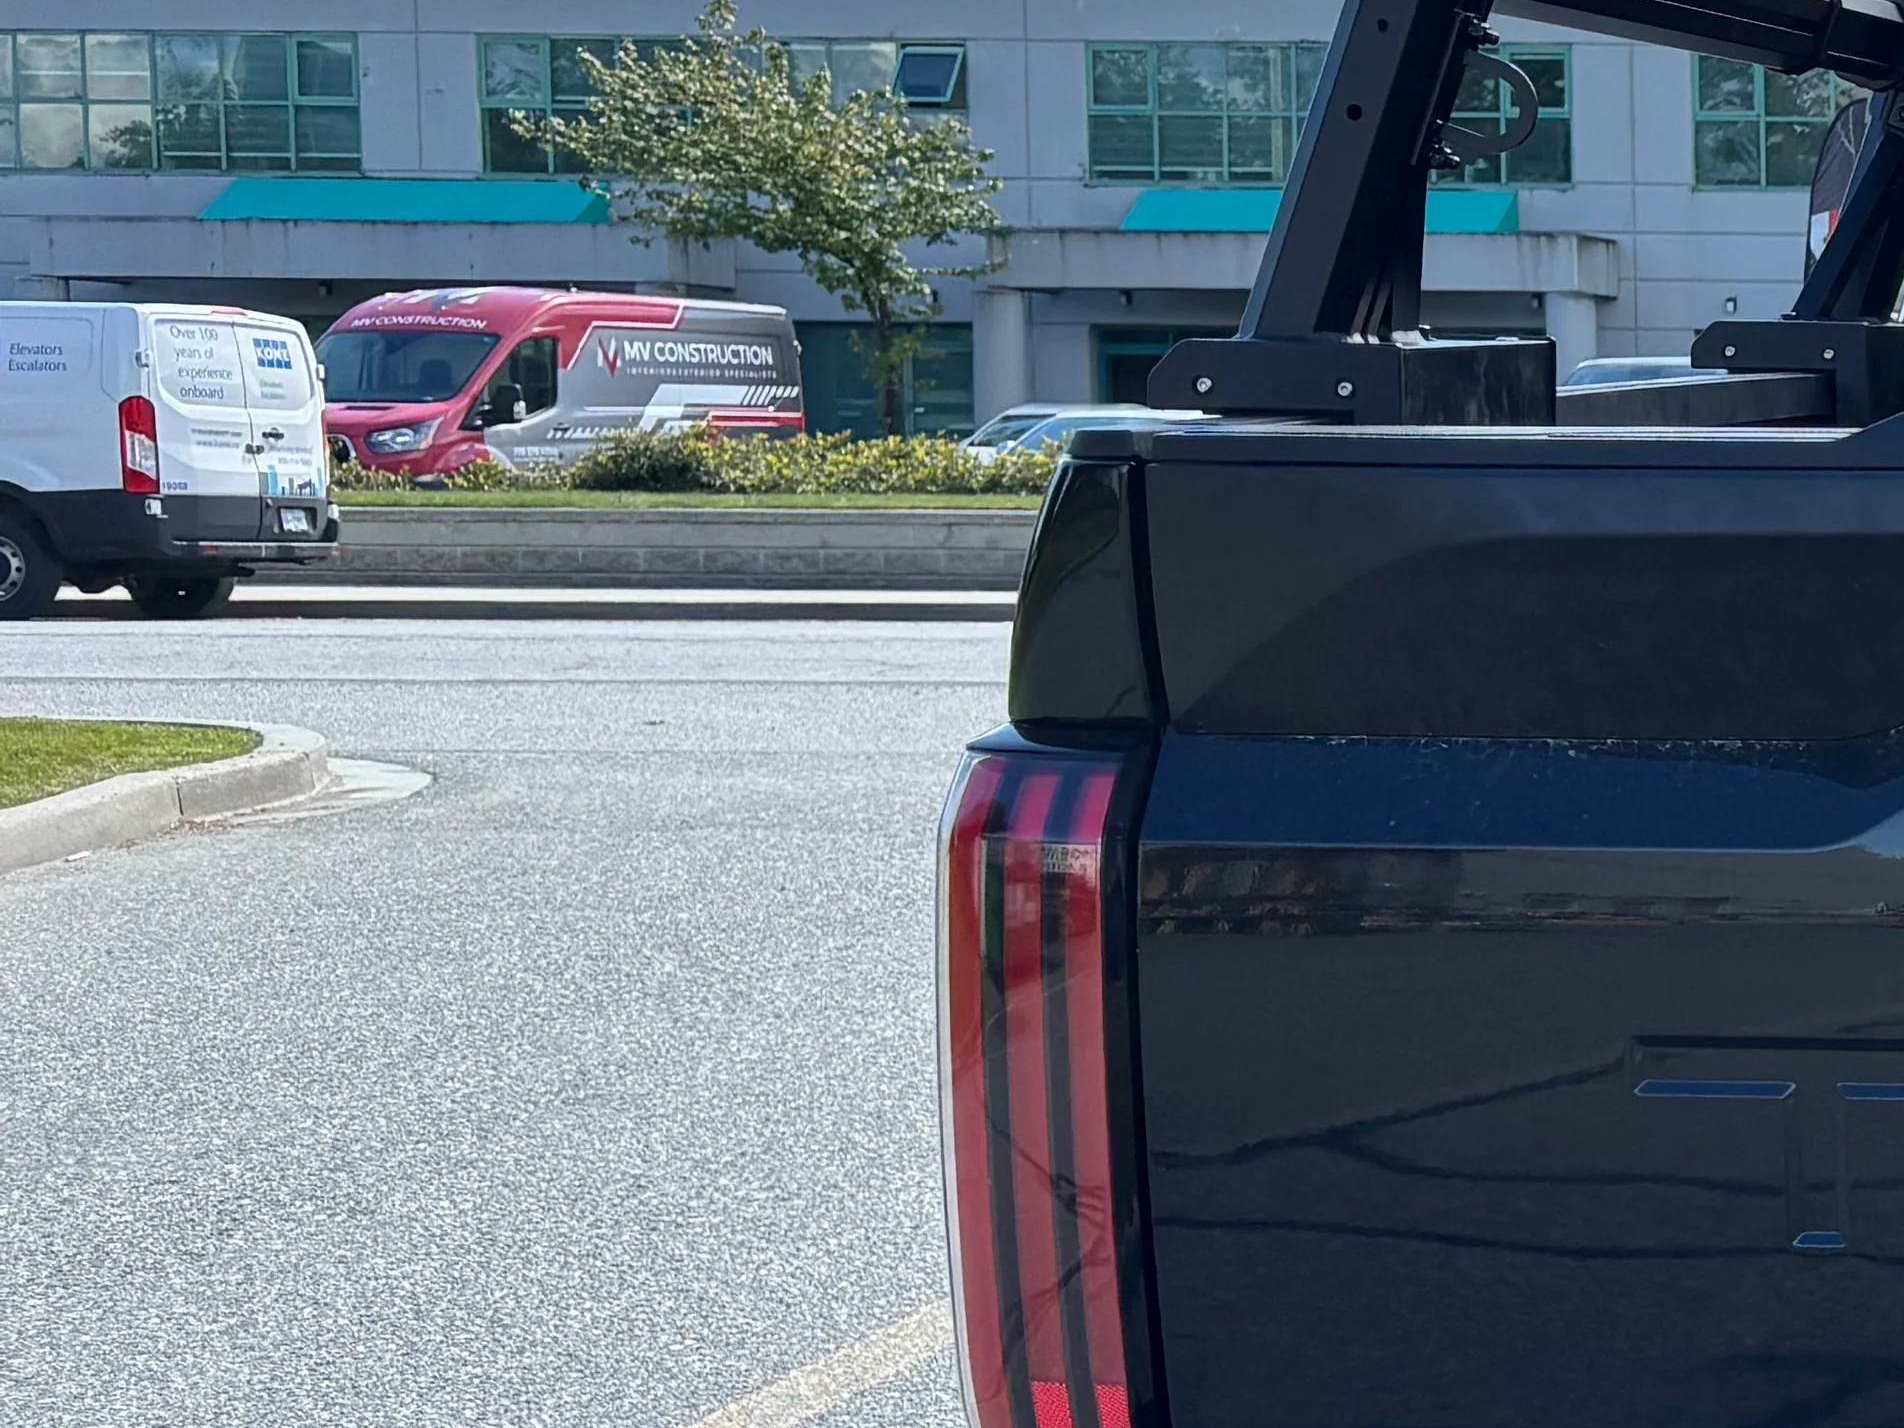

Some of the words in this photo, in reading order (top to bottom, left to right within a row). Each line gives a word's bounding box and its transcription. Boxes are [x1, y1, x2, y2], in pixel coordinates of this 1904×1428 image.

[376, 315, 488, 329] CONSTRUCTION
[10, 343, 63, 356] Elevators
[623, 340, 650, 361] MV
[654, 341, 774, 366] CONSTRUCTION
[9, 359, 67, 372] Escalators
[180, 384, 224, 400] onboard
